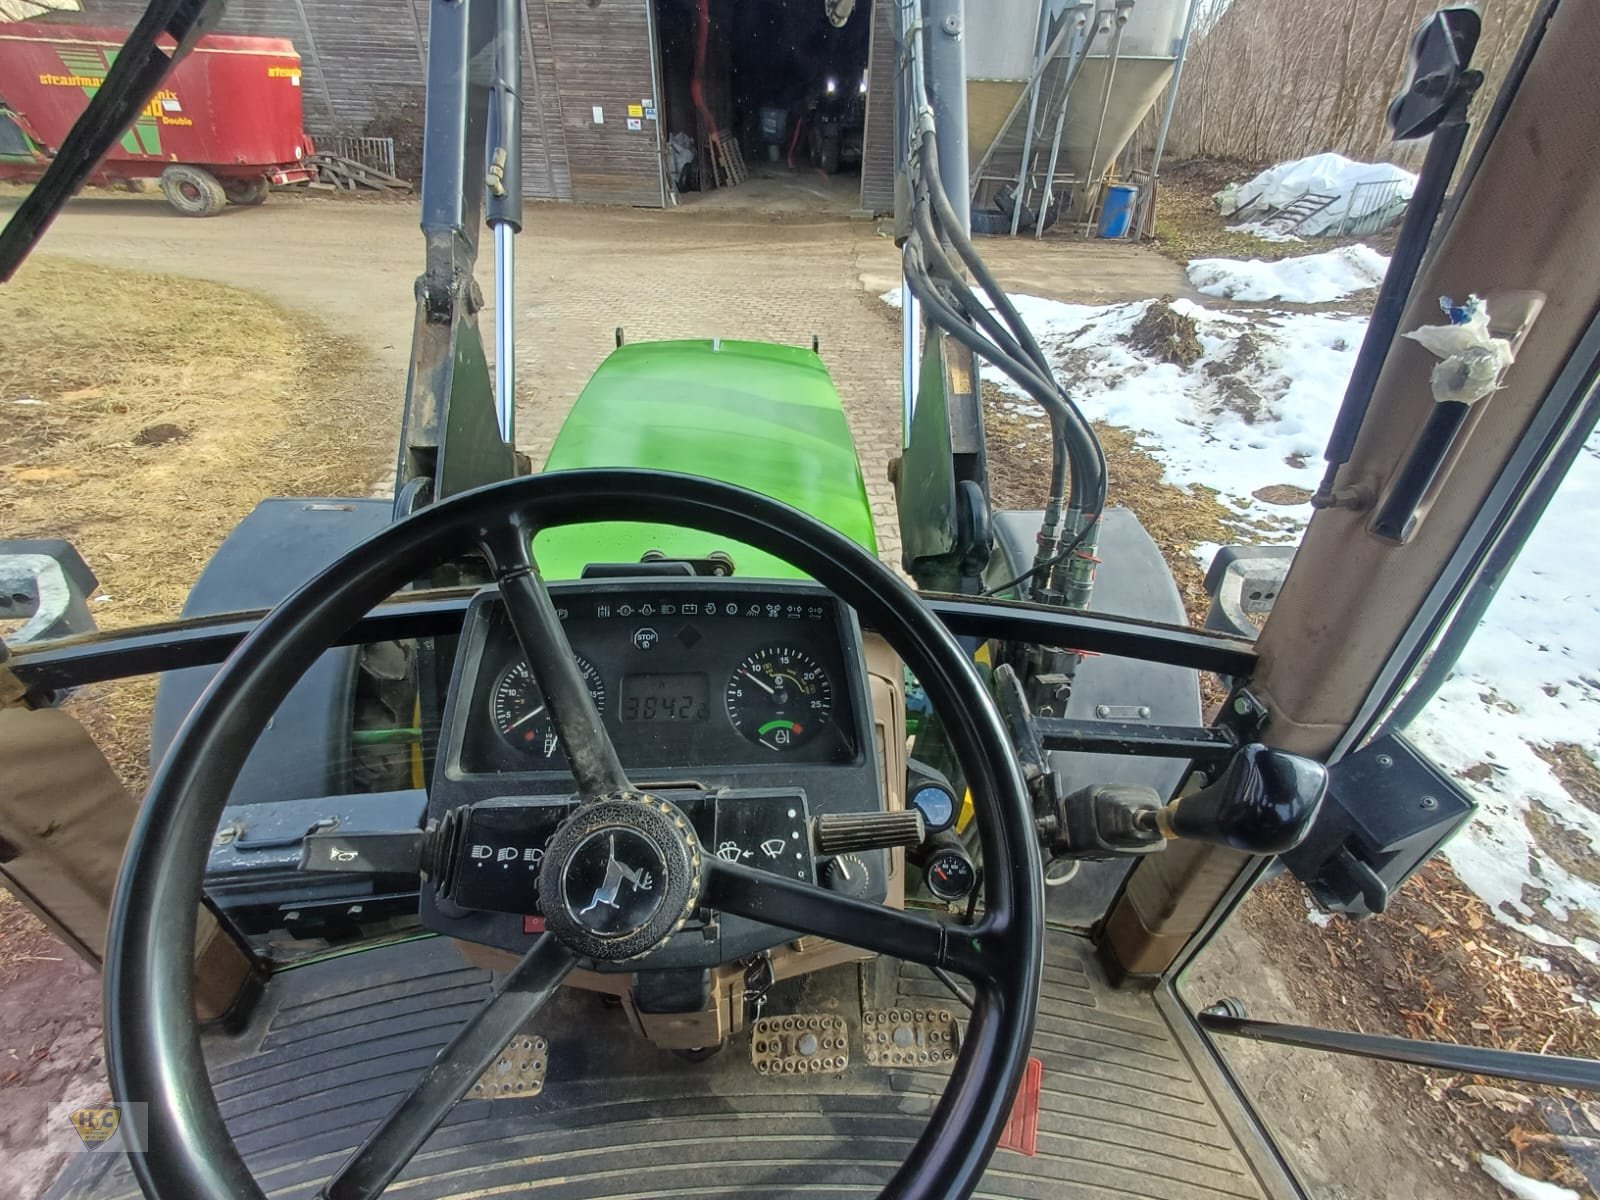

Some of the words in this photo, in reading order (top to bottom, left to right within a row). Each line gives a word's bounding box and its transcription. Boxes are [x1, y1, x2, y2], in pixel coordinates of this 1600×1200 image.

[39, 74, 104, 87] strautma
[637, 632, 655, 640] STOP
[752, 664, 761, 672] 10
[736, 689, 743, 697] 5
[505, 711, 512, 719] 5
